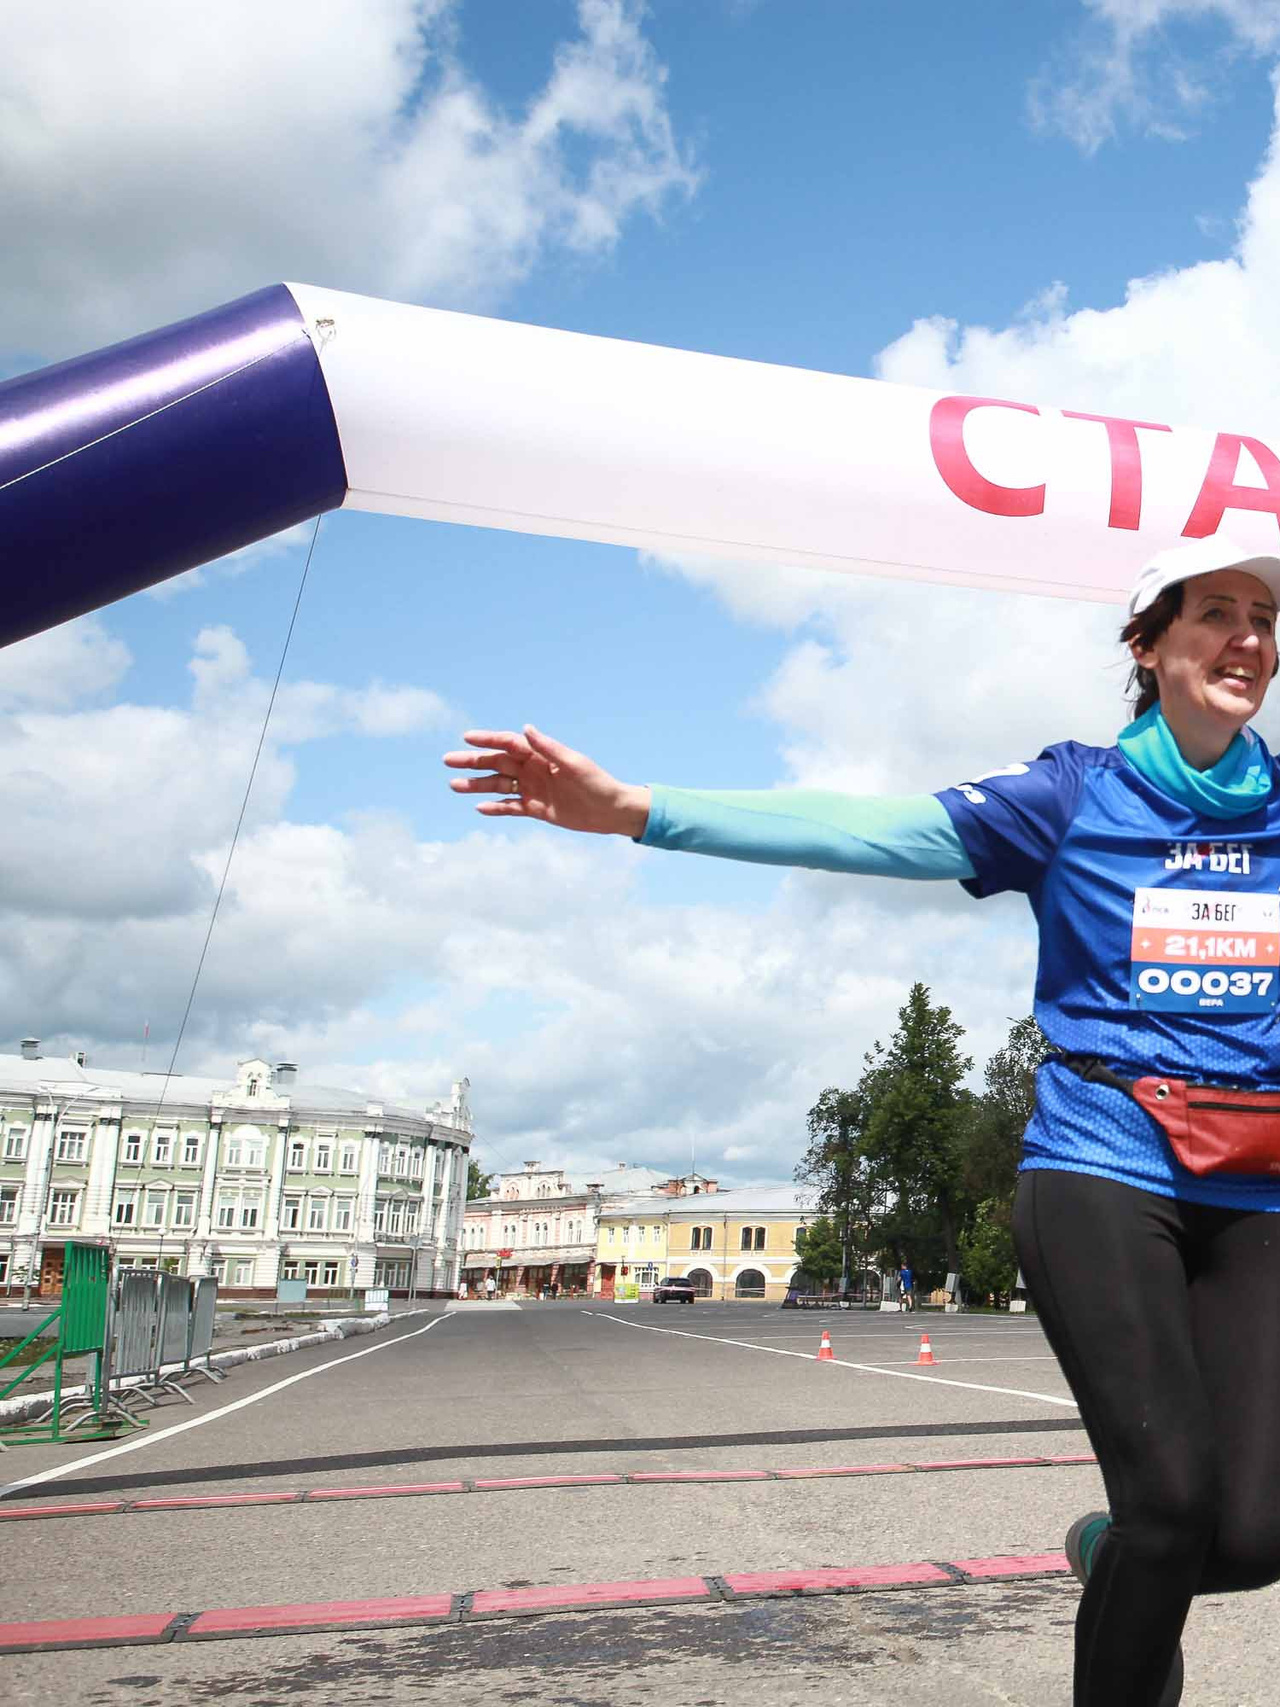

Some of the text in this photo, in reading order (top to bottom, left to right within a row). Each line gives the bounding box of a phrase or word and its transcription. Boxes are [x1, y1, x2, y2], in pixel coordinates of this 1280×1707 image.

[1164, 842, 1254, 875] ЗА БЕГ
[1191, 902, 1210, 921] ЗА
[1214, 903, 1237, 922] БЕГ
[1164, 934, 1257, 961] 21,1КМ
[1137, 967, 1274, 997] 00037
